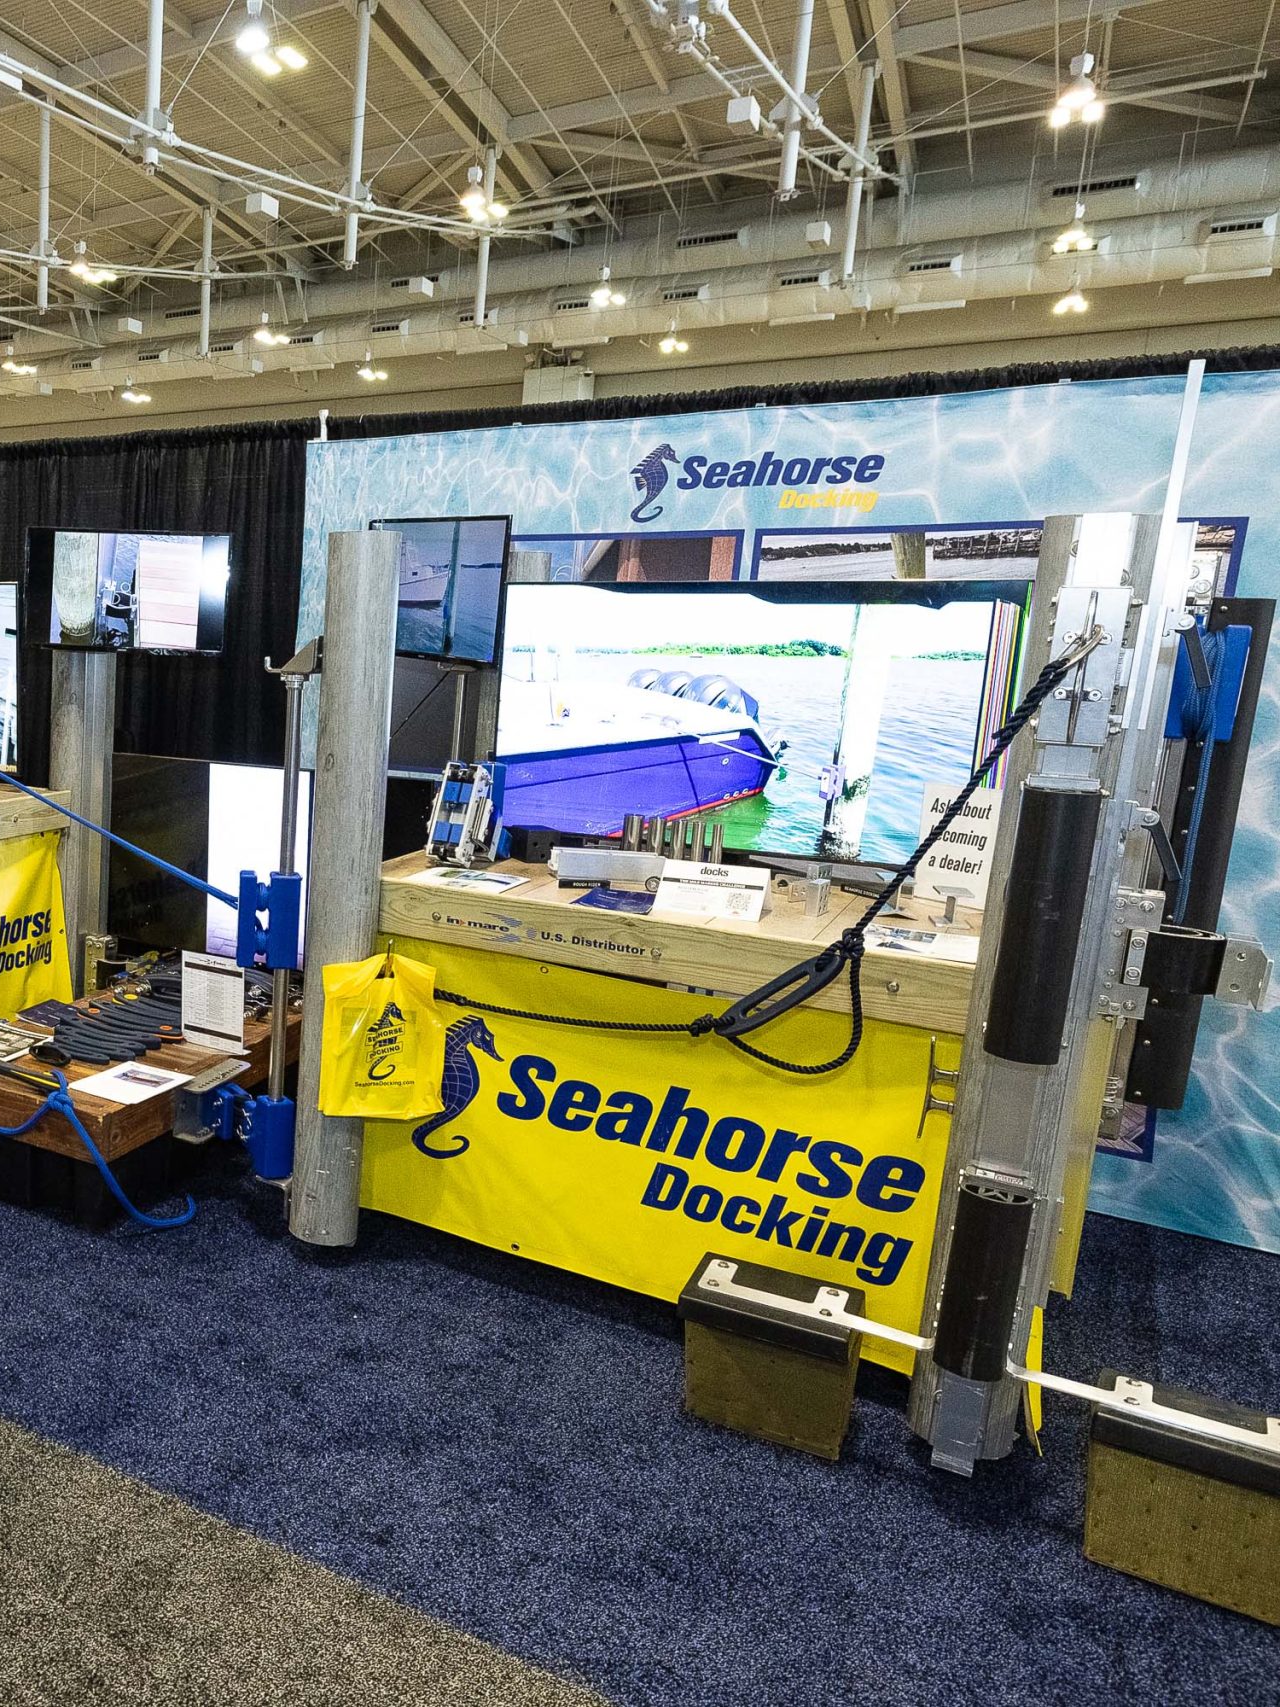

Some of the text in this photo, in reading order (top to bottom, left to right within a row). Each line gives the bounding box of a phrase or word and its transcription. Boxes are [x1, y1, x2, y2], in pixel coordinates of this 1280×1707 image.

[677, 451, 885, 490] Seahorse
[778, 489, 880, 513] Docking
[700, 866, 729, 878] docks
[928, 854, 983, 875] a dealer!
[540, 931, 646, 956] U.S. Distributor
[497, 1054, 926, 1213] Seahorse
[640, 1161, 914, 1287] Docking
